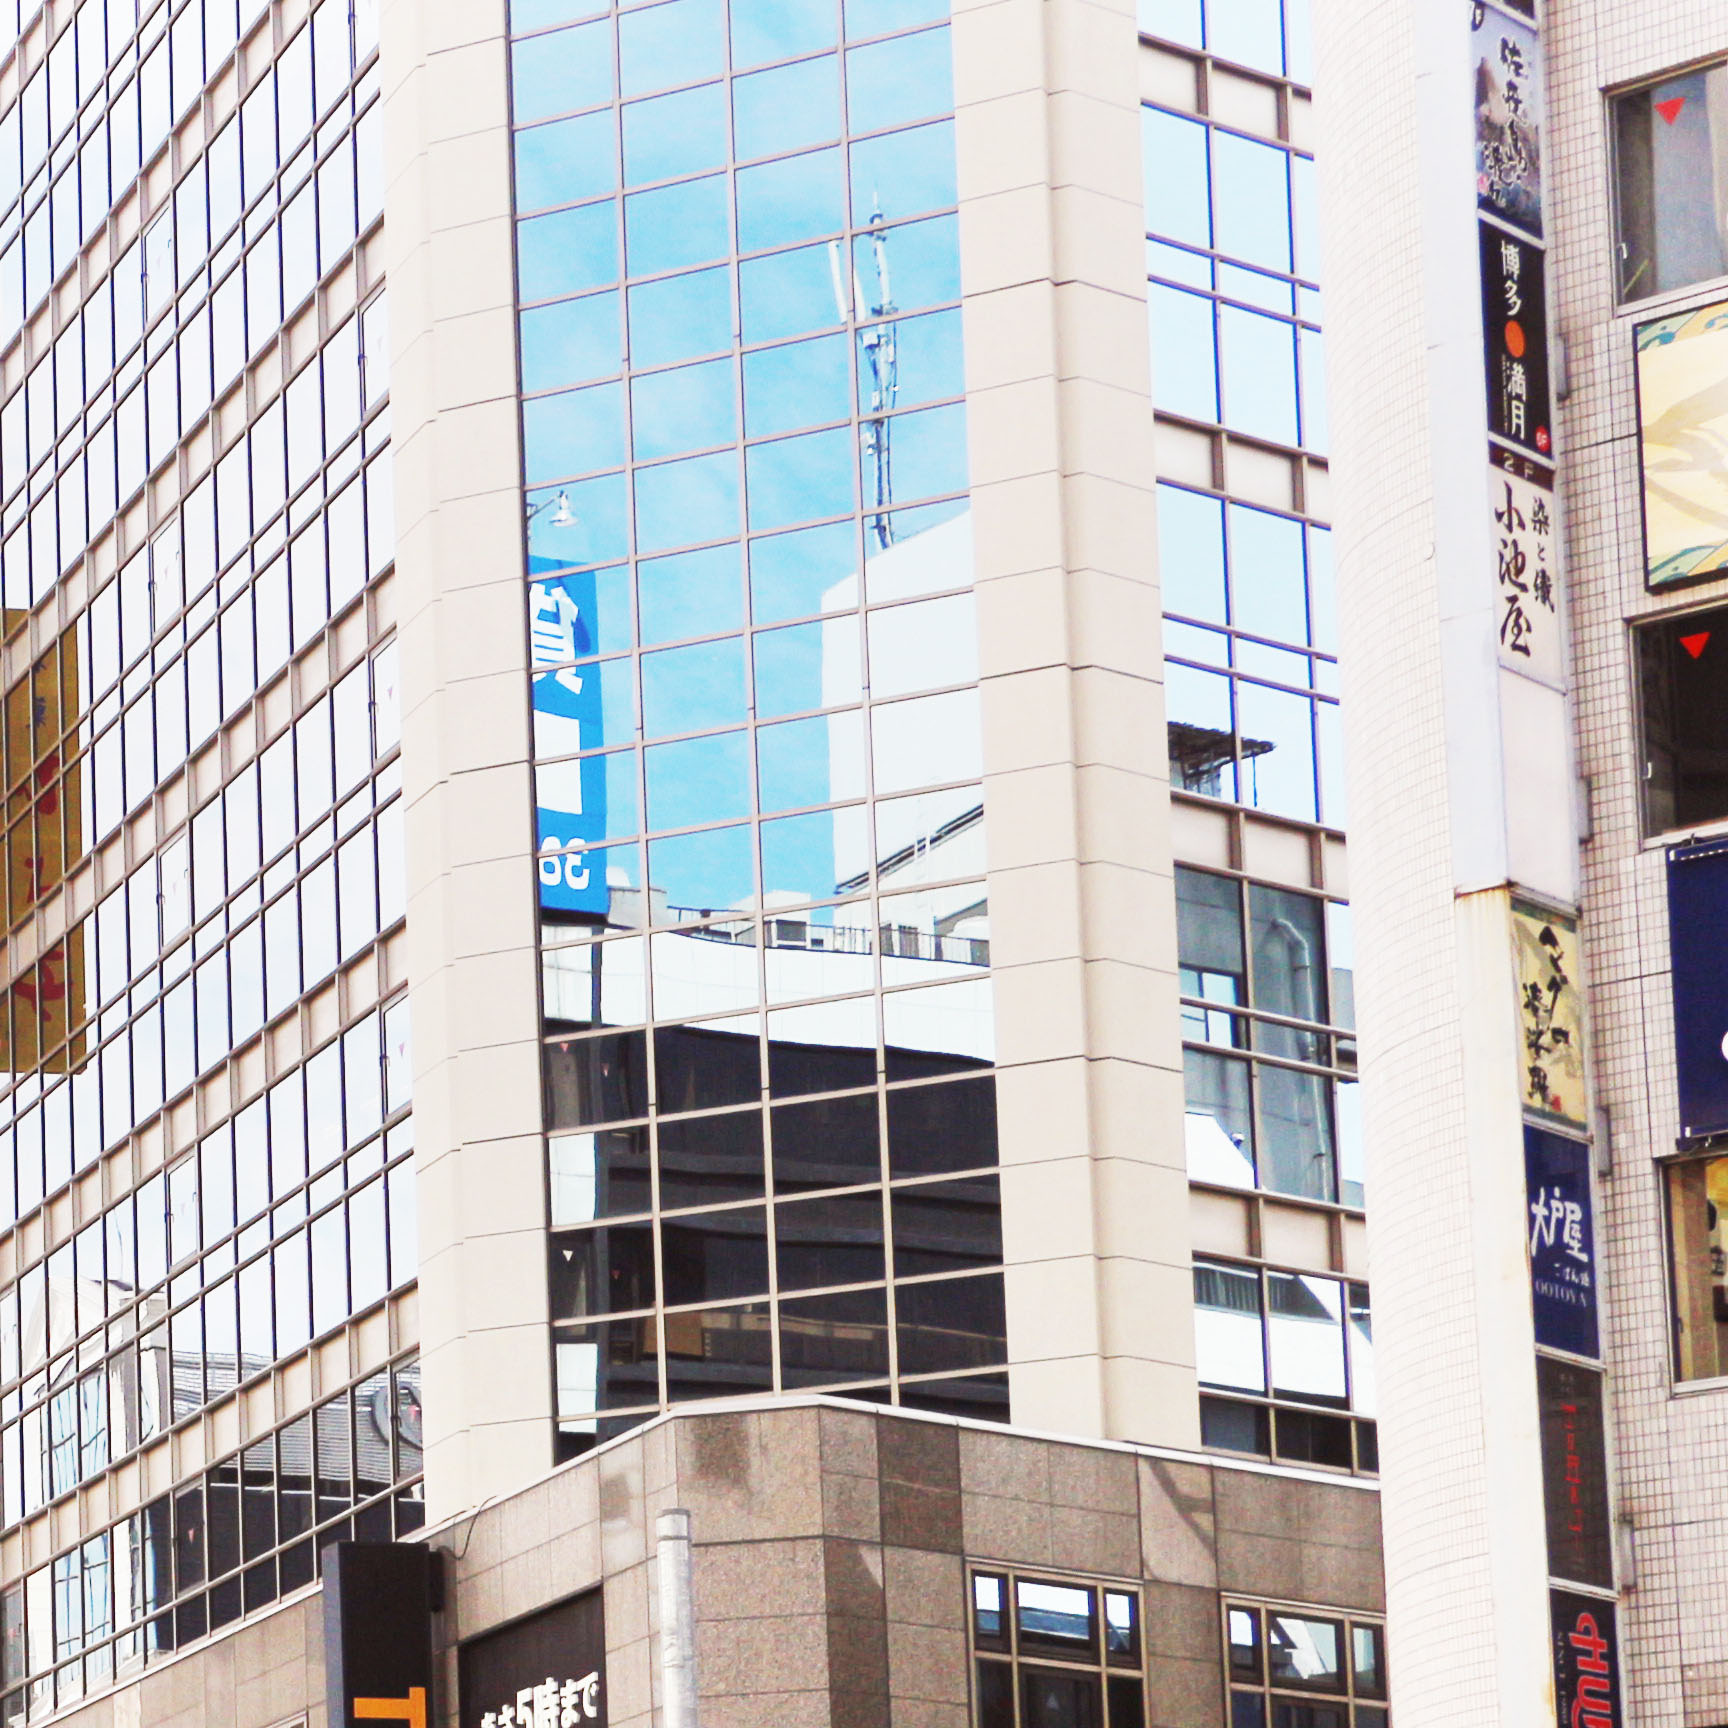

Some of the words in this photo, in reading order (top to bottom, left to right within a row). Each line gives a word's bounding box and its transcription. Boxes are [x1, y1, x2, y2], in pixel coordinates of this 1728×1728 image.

[1500, 239, 1523, 317] 博多
[1505, 360, 1529, 442] 満月
[1494, 480, 1532, 657] 小池屋
[1530, 1185, 1589, 1263] 大戸屋
